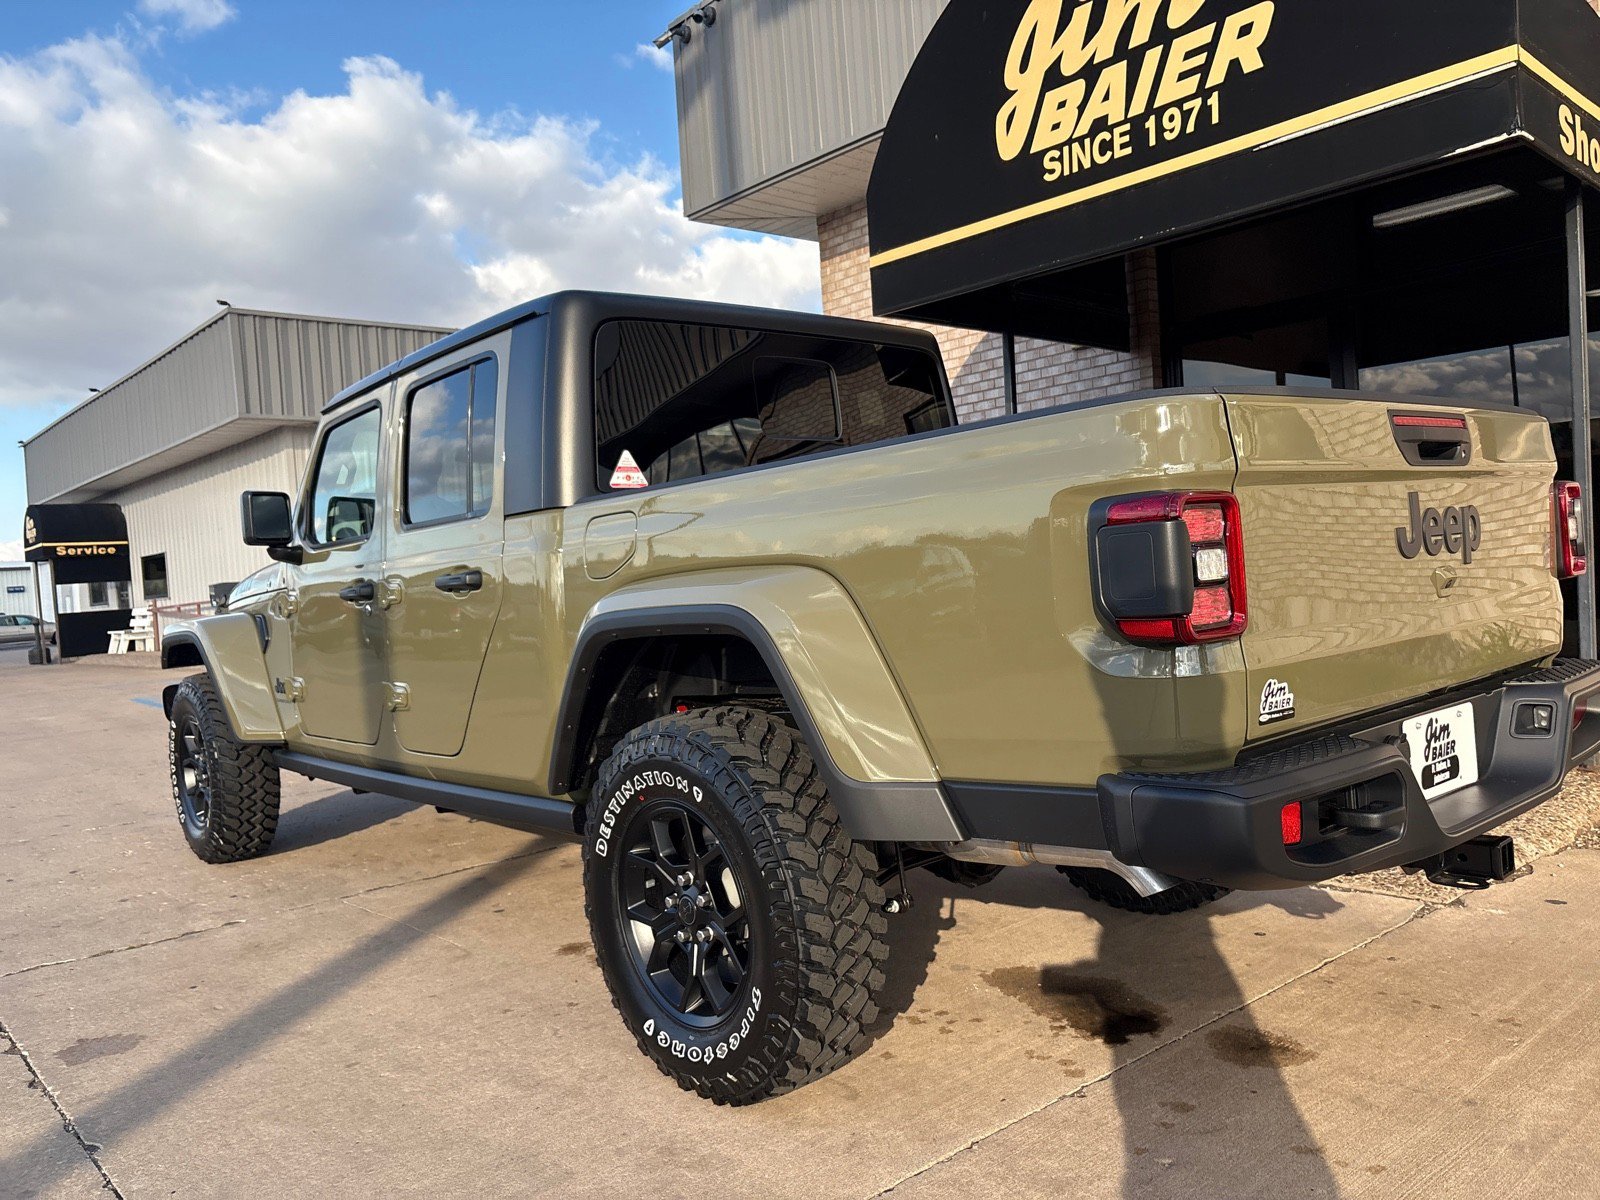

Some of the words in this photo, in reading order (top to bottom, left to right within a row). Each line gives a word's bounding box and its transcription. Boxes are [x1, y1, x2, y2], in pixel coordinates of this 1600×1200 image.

[1030, 1, 1275, 154] BAIER
[1042, 123, 1133, 182] SINCE
[1144, 91, 1219, 147] 1971
[56, 546, 116, 555] Service
[1395, 491, 1481, 564] Jeep
[1262, 681, 1287, 711] Jim
[1268, 697, 1291, 711] BAIER
[1424, 717, 1451, 762] Jim
[1431, 739, 1456, 761] BAIER
[595, 770, 690, 857] DESTINATION
[656, 986, 762, 1065] Firestone
